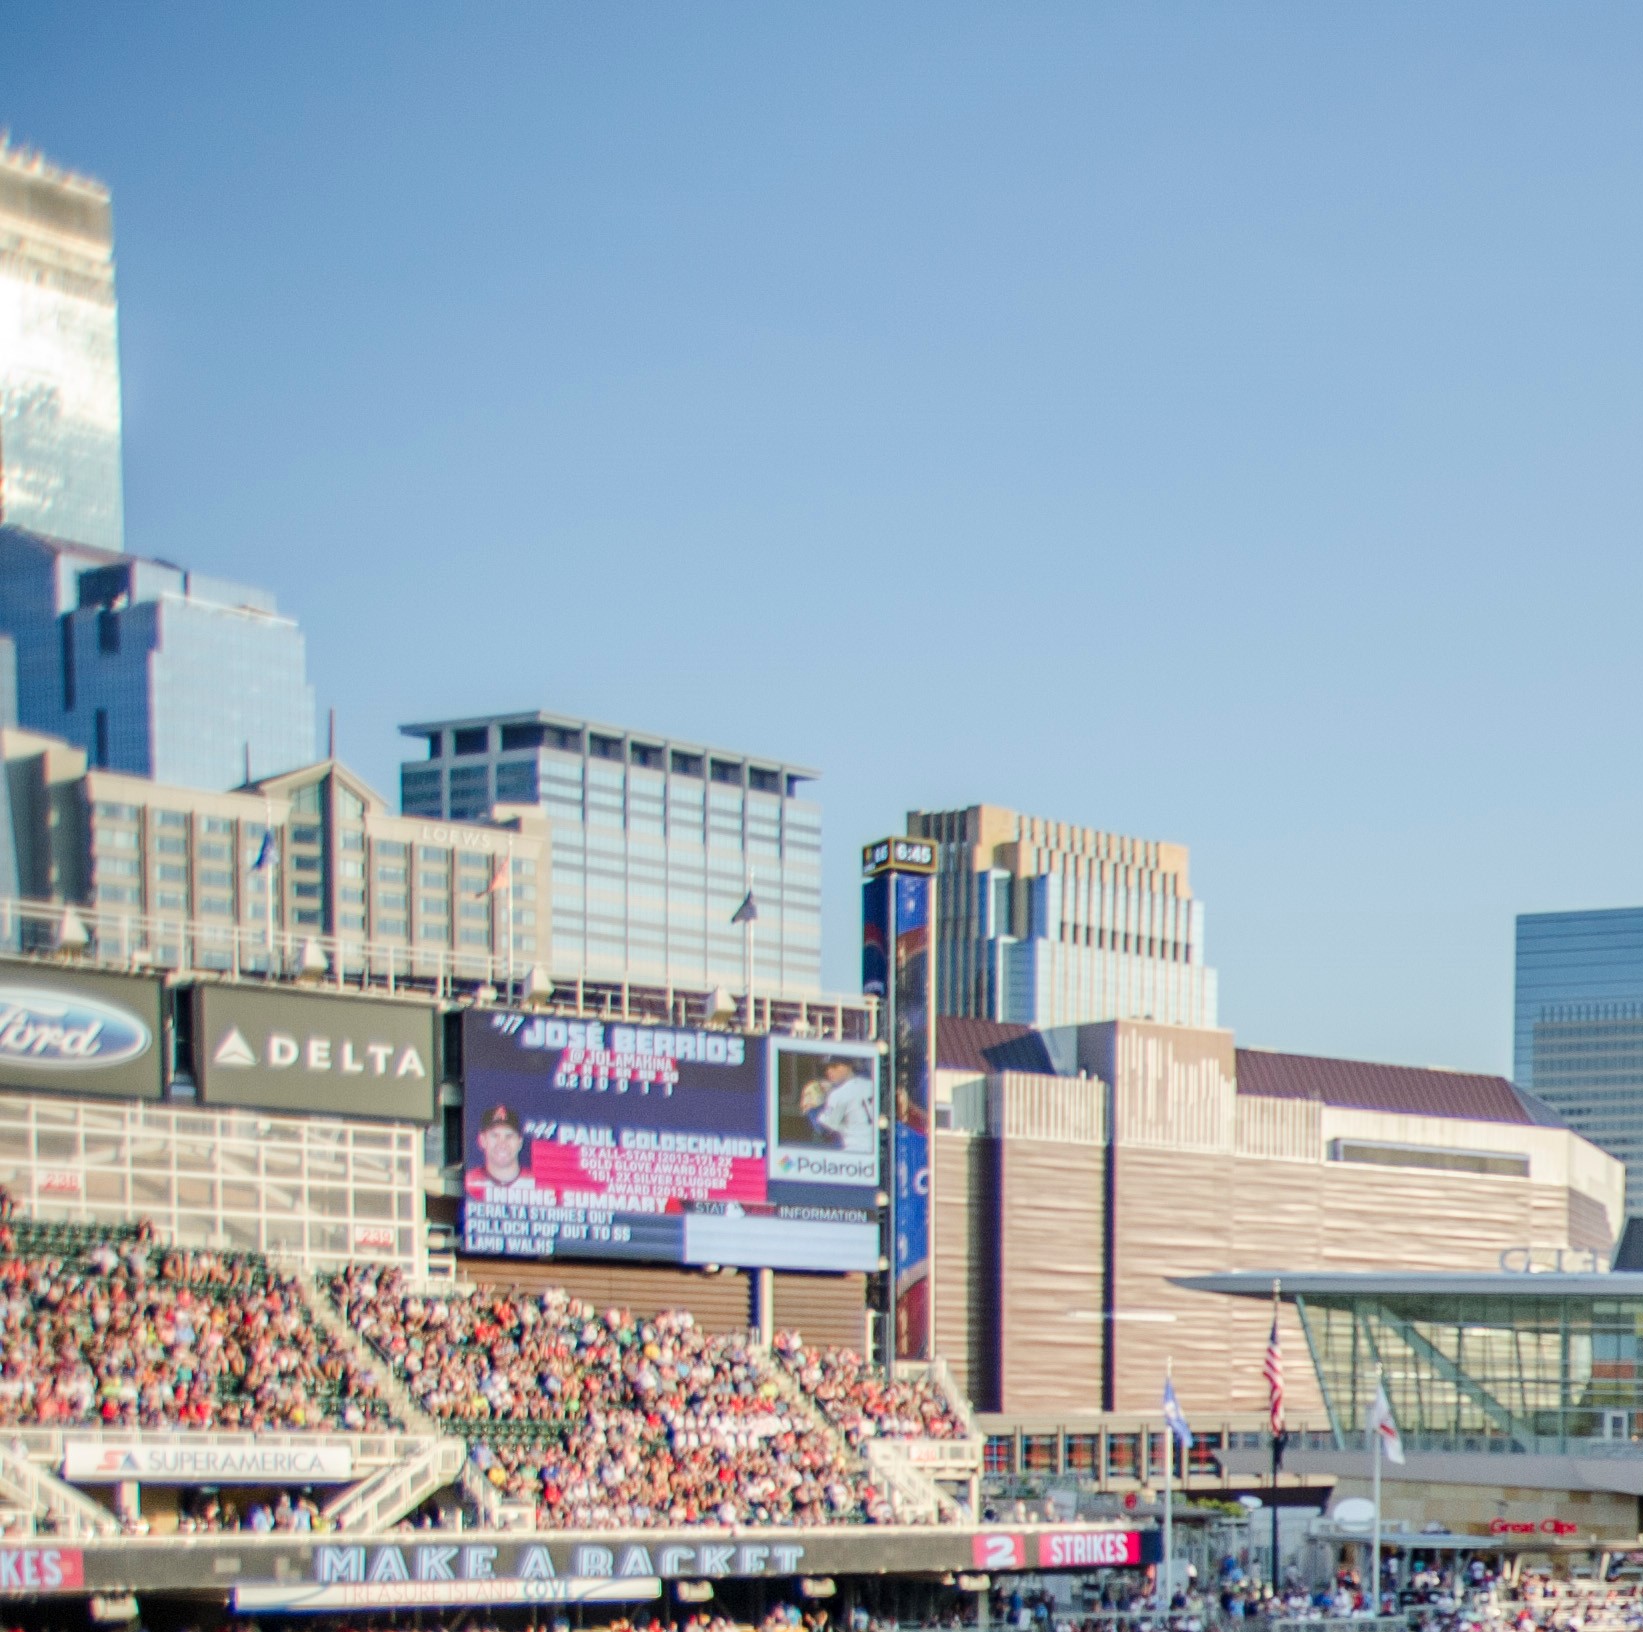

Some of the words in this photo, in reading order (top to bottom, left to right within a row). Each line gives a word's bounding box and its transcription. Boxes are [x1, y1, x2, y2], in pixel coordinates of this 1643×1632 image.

[423, 826, 491, 849] LOEWS
[895, 842, 931, 864] 6:45
[0, 1000, 107, 1058] ord
[522, 1019, 605, 1051] JOSÉ
[611, 1024, 745, 1066] BERRÍOS
[267, 1033, 426, 1079] DELTA
[560, 1125, 616, 1149] PAUL
[621, 1130, 767, 1159] GOLDSCHMIDT
[580, 1158, 612, 1170] GOLD
[615, 1160, 651, 1173] GLOVE
[654, 1163, 696, 1177] AWARD
[599, 1150, 657, 1163] ALL-STAR
[797, 1156, 876, 1179] Polaroid
[608, 1182, 650, 1195] AWARD
[633, 1173, 673, 1186] SILVER
[675, 1175, 727, 1190] SLUGGER
[485, 1186, 556, 1207] INNING
[563, 1190, 668, 1214] SUMMARY
[467, 1202, 527, 1221] PERALTA
[529, 1205, 585, 1223] STRIKES
[588, 1208, 616, 1225] OUT
[695, 1201, 726, 1215] STAT
[779, 1206, 869, 1223] INFORMATION
[531, 1221, 559, 1238] POP
[563, 1223, 589, 1239] OUT
[592, 1225, 610, 1241] TO
[613, 1226, 632, 1242] SS
[467, 1235, 505, 1252] LAMB
[507, 1237, 555, 1255] WALKS
[150, 1450, 326, 1473] SUPERAMERICA
[1489, 1516, 1536, 1535] Great
[985, 1535, 1017, 1567] 2
[1051, 1532, 1129, 1564] STRIKES
[318, 1546, 498, 1582] MAKE
[521, 1546, 557, 1578] A
[577, 1545, 805, 1578] RACKET
[446, 1579, 518, 1602] ISLAND
